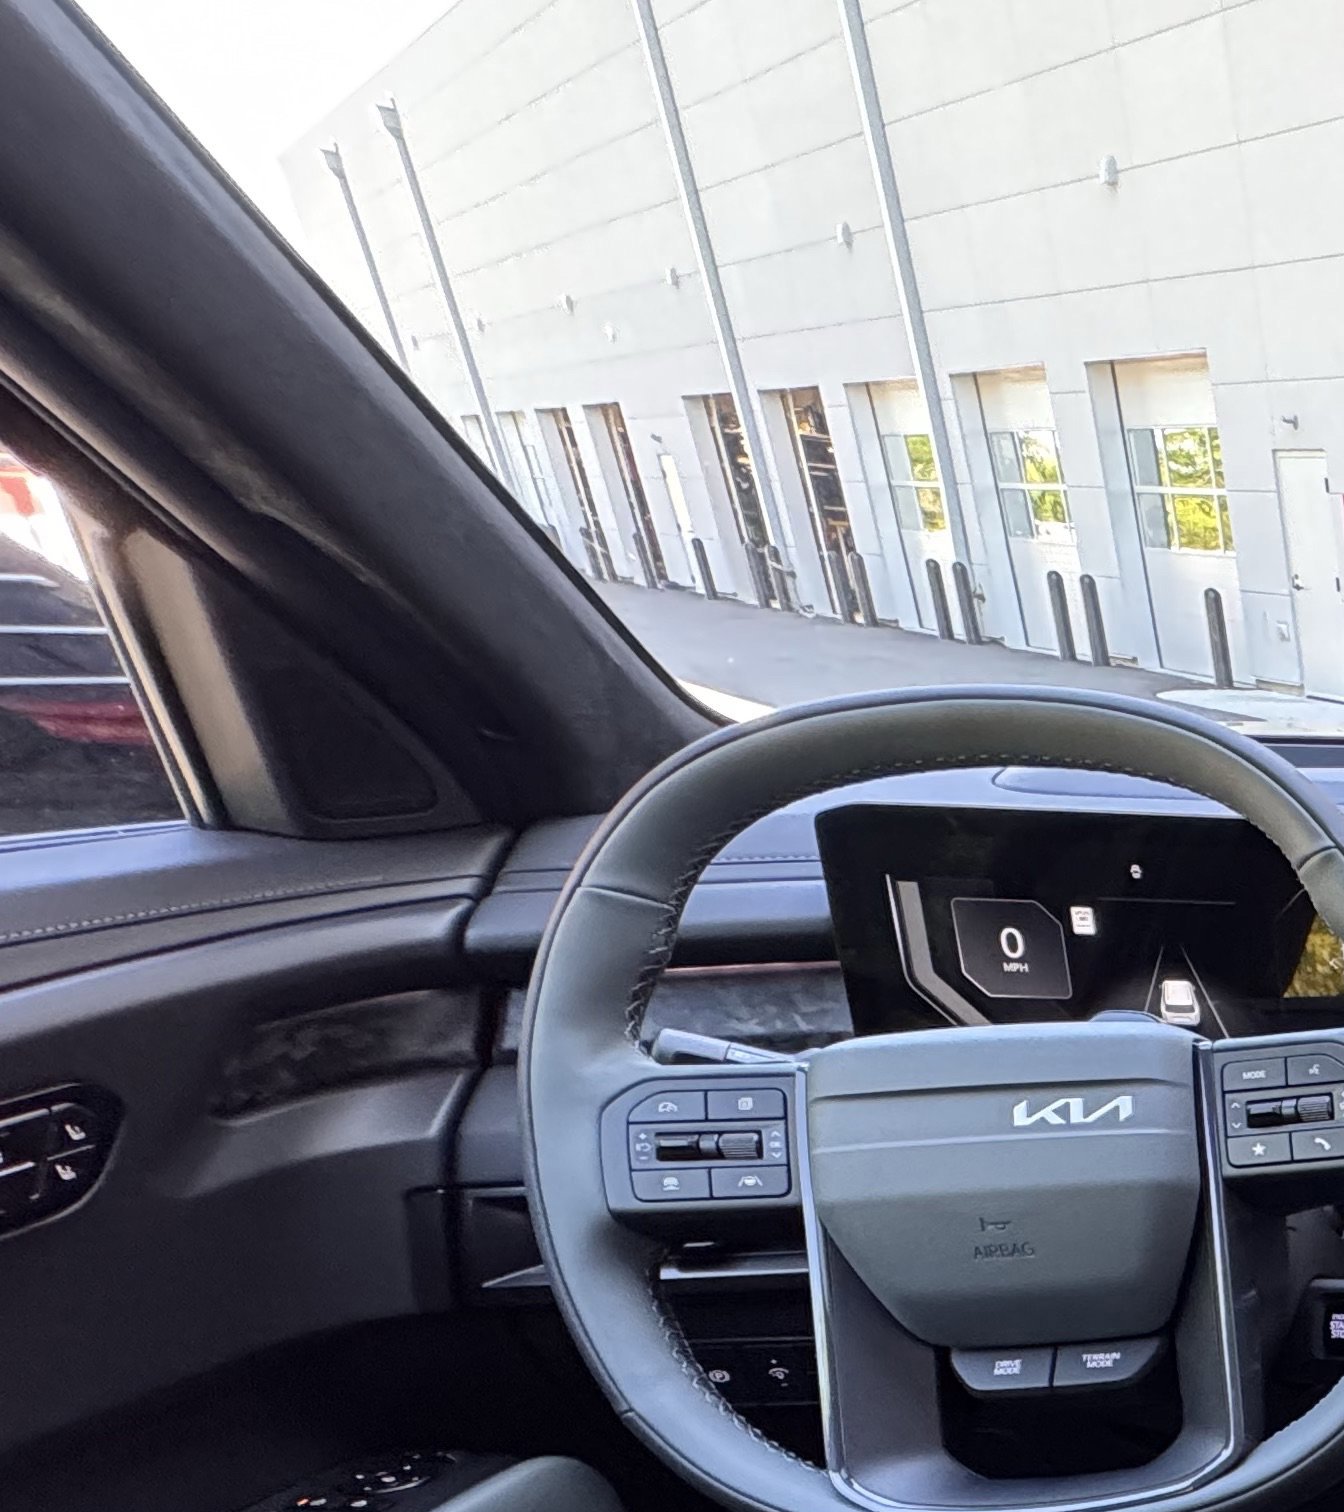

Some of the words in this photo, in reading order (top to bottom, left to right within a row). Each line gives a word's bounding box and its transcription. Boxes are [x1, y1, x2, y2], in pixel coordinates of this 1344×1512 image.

[1000, 927, 1025, 959] 0
[1002, 962, 1030, 973] MPH
[1242, 1069, 1267, 1080] MODE
[1013, 1095, 1133, 1127] KIA
[973, 1241, 1036, 1260] AIRBAG
[995, 1358, 1022, 1368] DRIVE
[1086, 1359, 1114, 1369] MODE
[993, 1366, 1021, 1376] MODE
